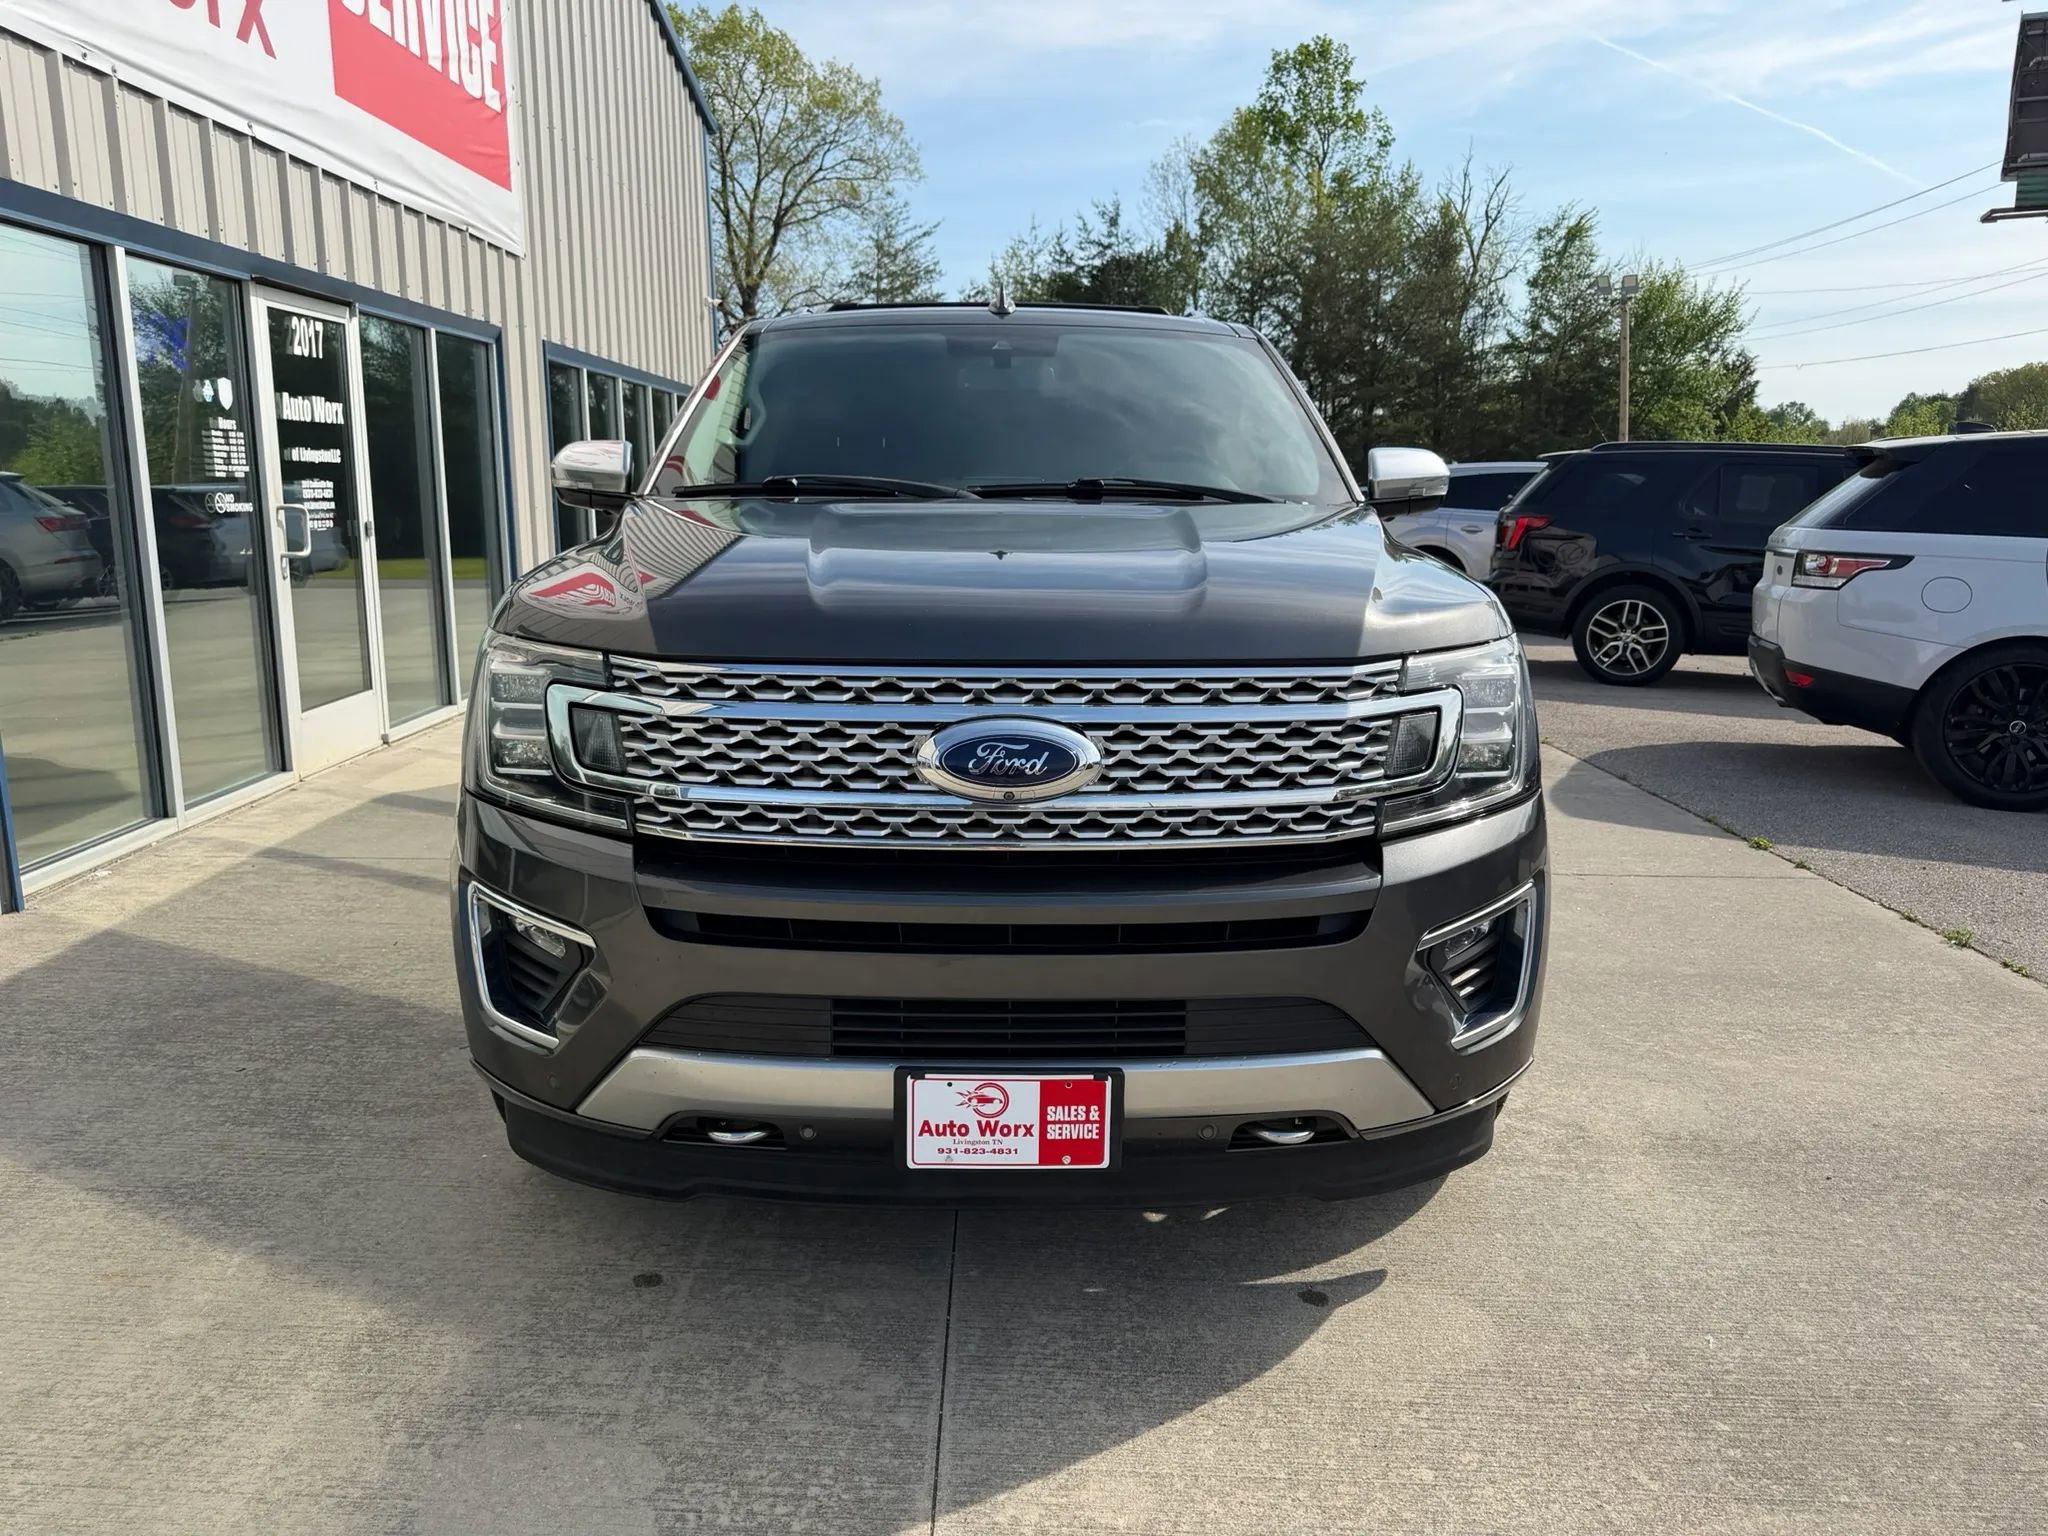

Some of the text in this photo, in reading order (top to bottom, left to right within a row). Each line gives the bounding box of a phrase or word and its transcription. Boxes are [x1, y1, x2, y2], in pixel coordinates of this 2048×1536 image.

[291, 316, 324, 359] 2017
[282, 391, 345, 425] Auto Worx
[224, 493, 235, 503] NO
[225, 502, 254, 513] SMOKING
[968, 742, 1050, 776] Ford
[1047, 1105, 1100, 1121] SALES &
[918, 1119, 1036, 1138] Auto Worx
[1046, 1123, 1100, 1140] SERVICE
[937, 1147, 1019, 1156] 931-823-4831
